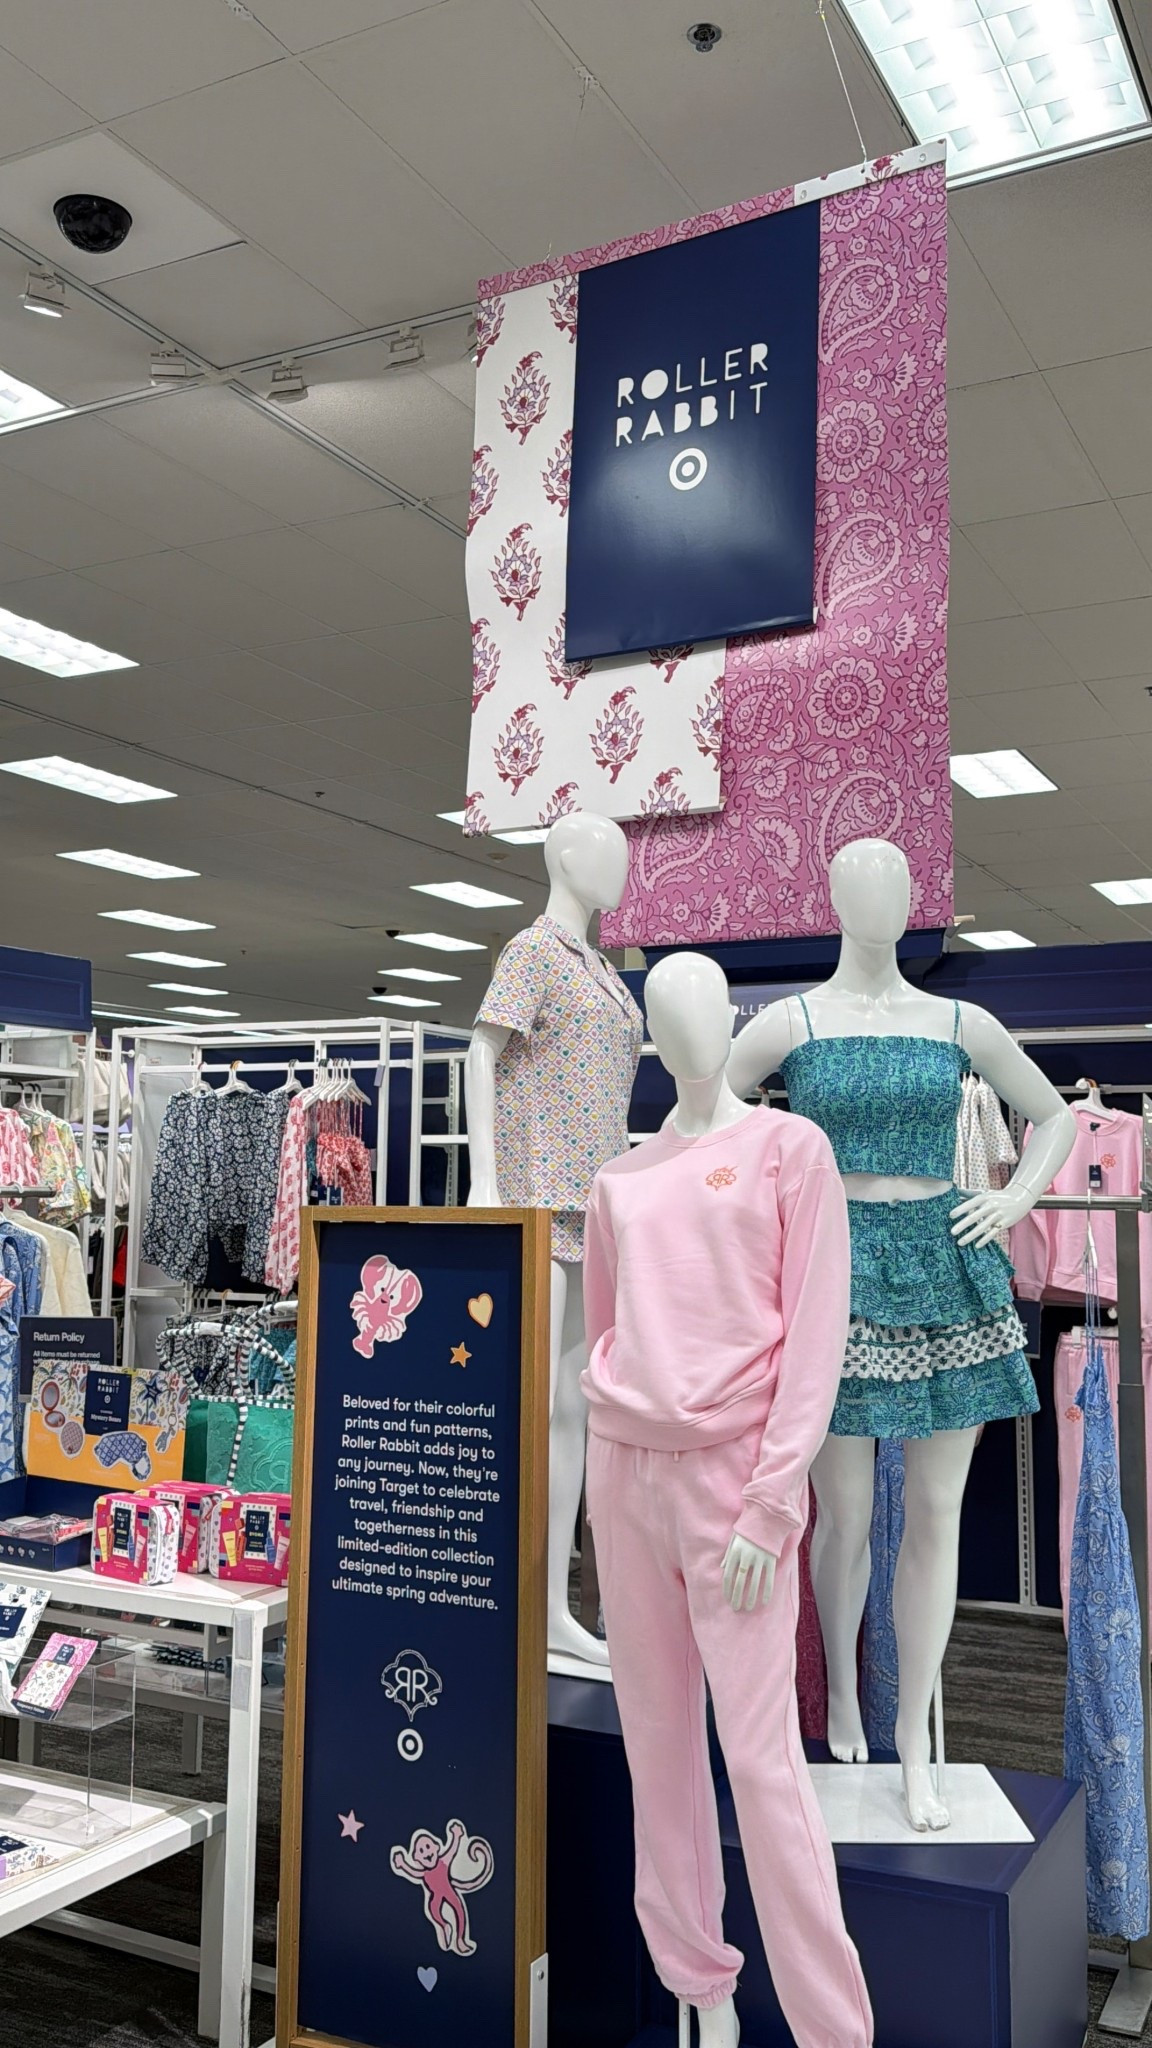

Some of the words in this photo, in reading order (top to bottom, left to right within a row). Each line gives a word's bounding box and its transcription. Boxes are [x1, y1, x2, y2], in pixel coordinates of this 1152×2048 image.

[617, 342, 769, 408] ROLLER
[615, 382, 768, 447] RABBIT
[33, 1331, 60, 1342] Return
[61, 1332, 85, 1344] Policy
[77, 1351, 101, 1359] returned
[342, 1394, 390, 1410] Beloved
[392, 1397, 411, 1412] for
[413, 1399, 444, 1414] their
[446, 1402, 495, 1418] colorful
[344, 1415, 380, 1431] prints
[382, 1418, 407, 1432] and
[409, 1419, 431, 1434] fun
[434, 1423, 492, 1441] patterns,
[341, 1434, 377, 1450] Roller
[379, 1436, 421, 1454] Rabbit
[423, 1441, 455, 1457] adds
[457, 1443, 478, 1462] joy
[481, 1447, 495, 1460] to
[337, 1457, 361, 1473] any
[363, 1456, 415, 1477] journey.
[418, 1460, 449, 1479] Now,
[452, 1464, 498, 1483] they're
[334, 1474, 376, 1494] joining
[379, 1477, 420, 1497] Target
[422, 1483, 436, 1496] to
[438, 1484, 500, 1503] celebrate
[349, 1497, 388, 1514] travel,
[391, 1499, 455, 1522] friendship
[458, 1508, 484, 1522] and
[354, 1518, 436, 1538] togetherness
[439, 1525, 450, 1540] in
[453, 1527, 478, 1543] this
[337, 1535, 428, 1558] limited-edition
[431, 1547, 494, 1566] collection
[339, 1556, 396, 1577] designed
[399, 1564, 412, 1578] to
[415, 1564, 458, 1584] inspire
[461, 1574, 492, 1589] your
[332, 1576, 383, 1595] ultimate
[386, 1584, 426, 1604] spring
[429, 1589, 498, 1610] adventure.
